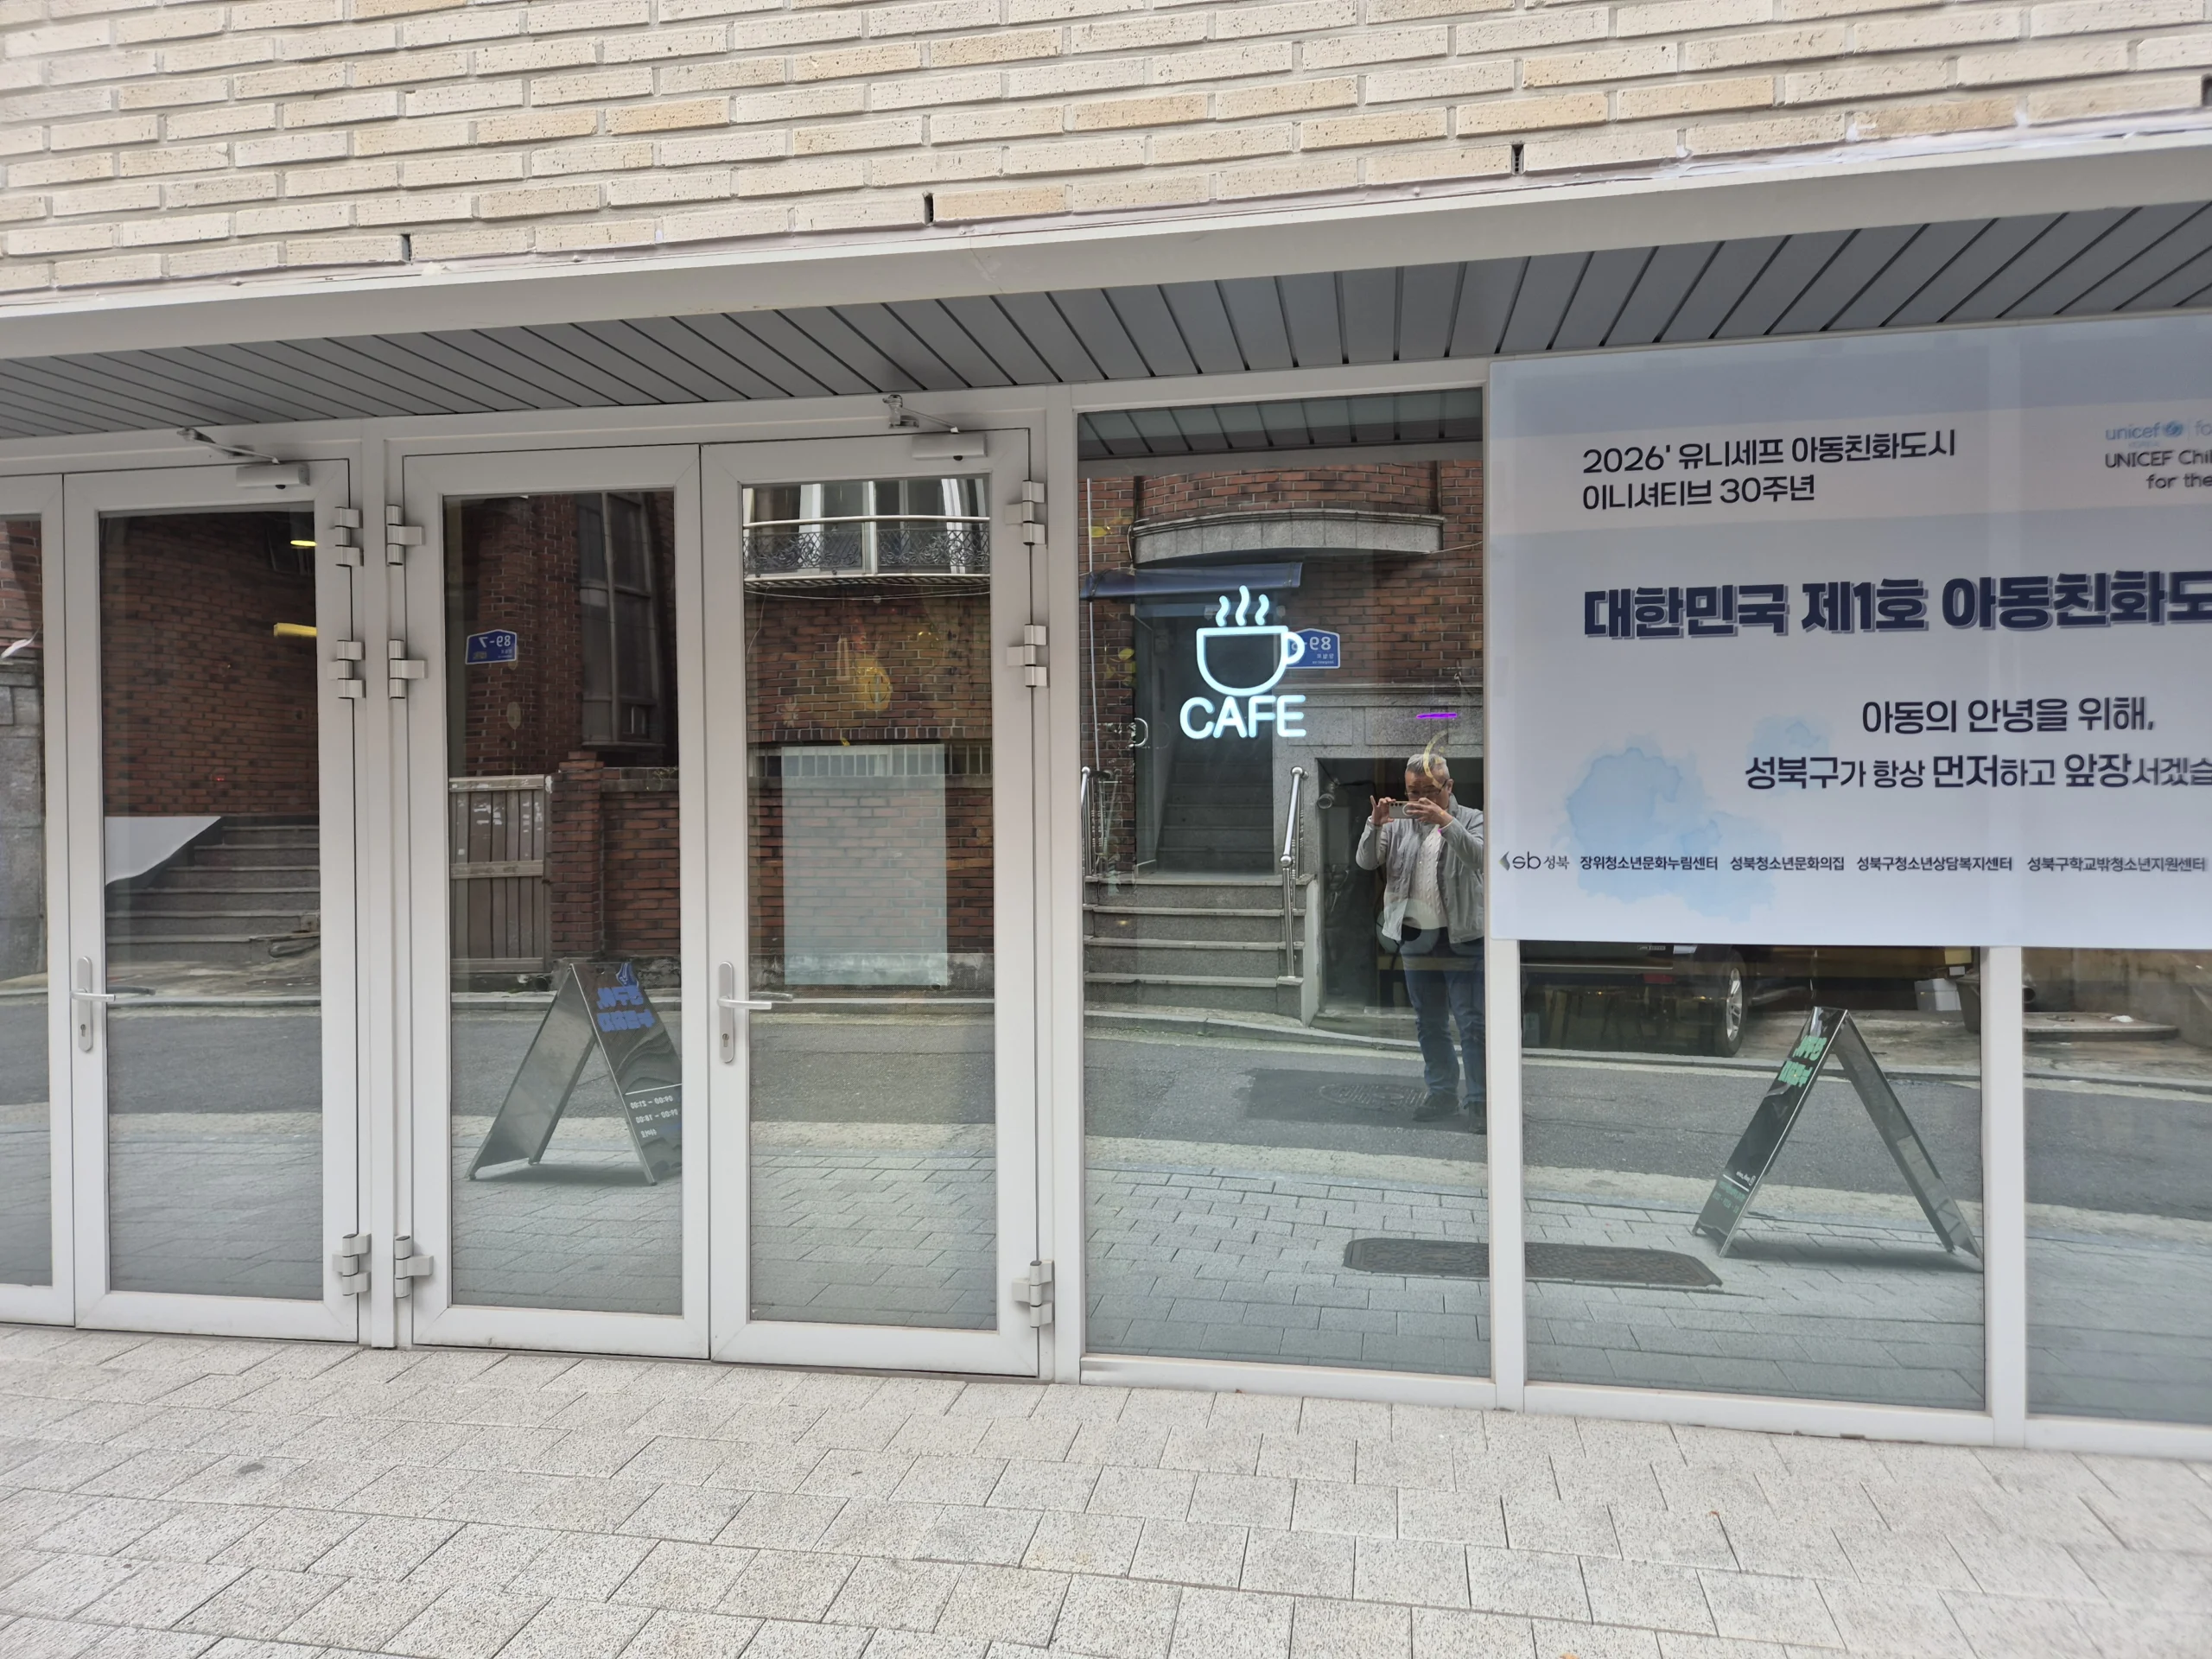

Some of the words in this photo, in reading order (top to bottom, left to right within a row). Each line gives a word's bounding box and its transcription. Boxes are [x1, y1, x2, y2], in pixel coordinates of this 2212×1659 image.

[2105, 422, 2161, 440] unicef
[1678, 440, 1784, 468] 유니세프
[1792, 429, 1957, 465] 아동친화도시
[2105, 450, 2175, 467] UNICEF
[2145, 473, 2179, 489] for
[2183, 472, 2212, 488] the
[1582, 480, 1713, 512] 이니셔티브
[1719, 473, 1815, 505] 30주년
[1584, 582, 1790, 639] 대한민국
[1801, 577, 1929, 634] 제1호
[1942, 569, 2212, 632] 아동친화도
[1179, 694, 1306, 740] CAFE
[1862, 699, 1959, 734] 아동의
[1967, 696, 2069, 734] 안녕을
[2077, 695, 2156, 733] 위해,
[1745, 754, 1866, 791] 성북구가
[1873, 759, 1926, 789] 항상
[1932, 754, 2056, 789] 먼저하고
[1543, 855, 1570, 870] 성북
[1580, 855, 1719, 871] 장위청소년문화누림센터
[1729, 855, 1846, 872] 성북청소년문화의집
[1856, 855, 2013, 872] 성북구청소년상담복지센터
[2026, 856, 2206, 873] 성북구학교밖청소년지원센터
